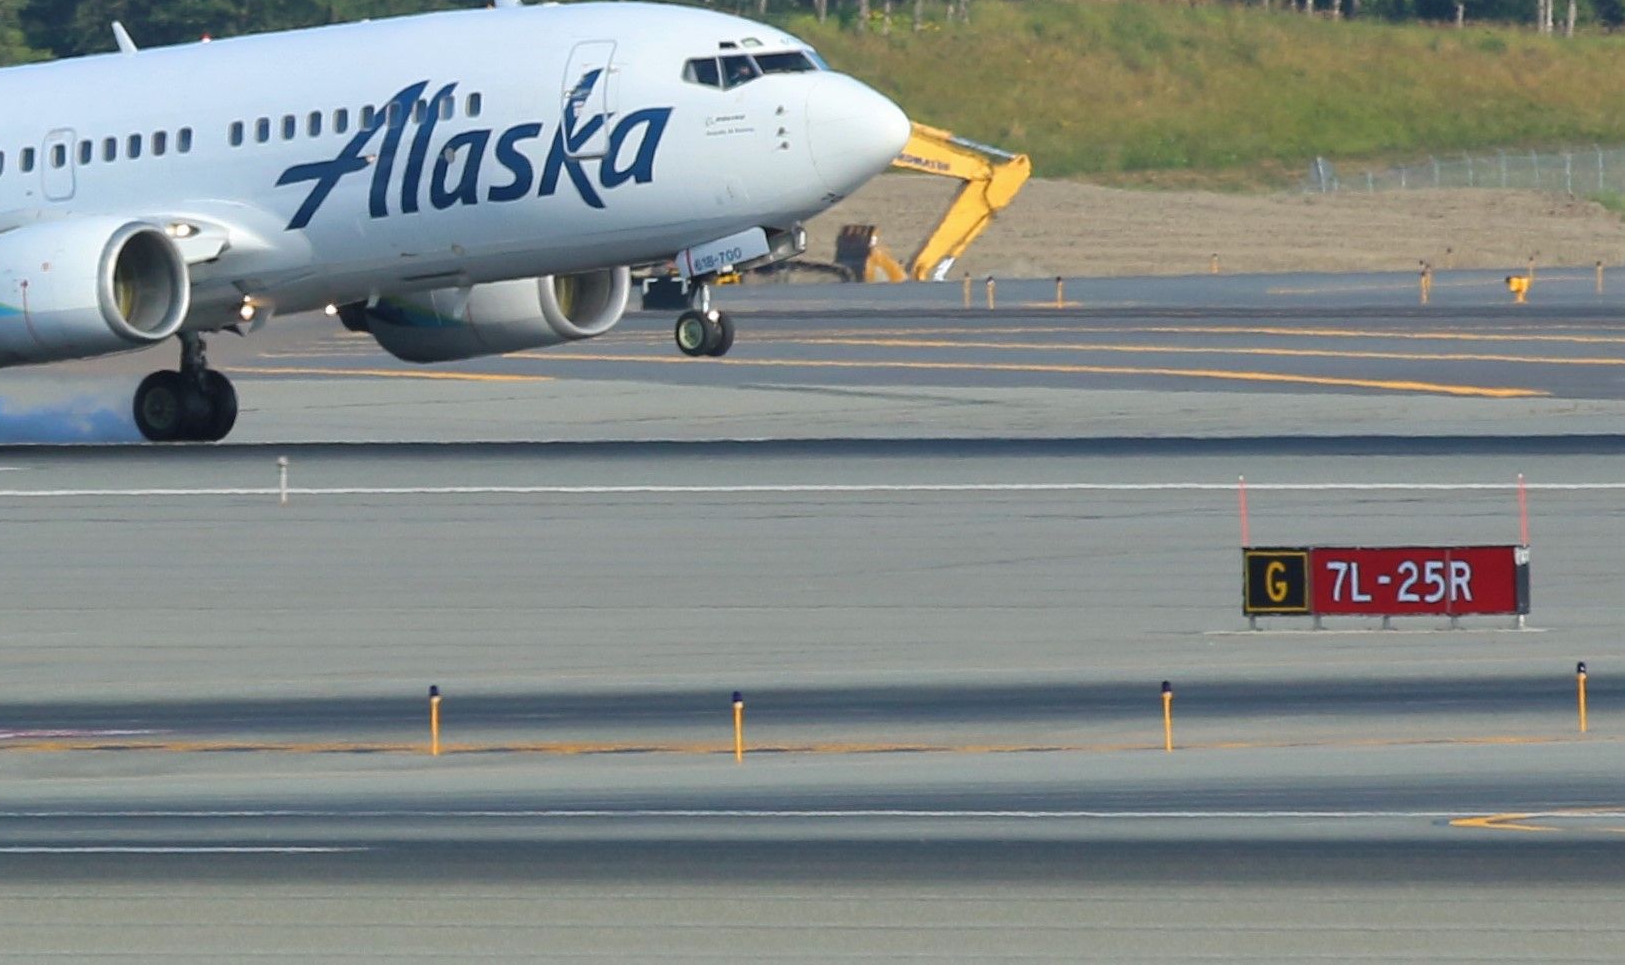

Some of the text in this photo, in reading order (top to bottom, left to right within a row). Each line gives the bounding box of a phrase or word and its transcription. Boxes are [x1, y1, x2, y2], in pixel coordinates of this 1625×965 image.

[275, 68, 673, 230] Alaska
[1266, 561, 1287, 602] G
[1327, 560, 1472, 603] 7L-25R
